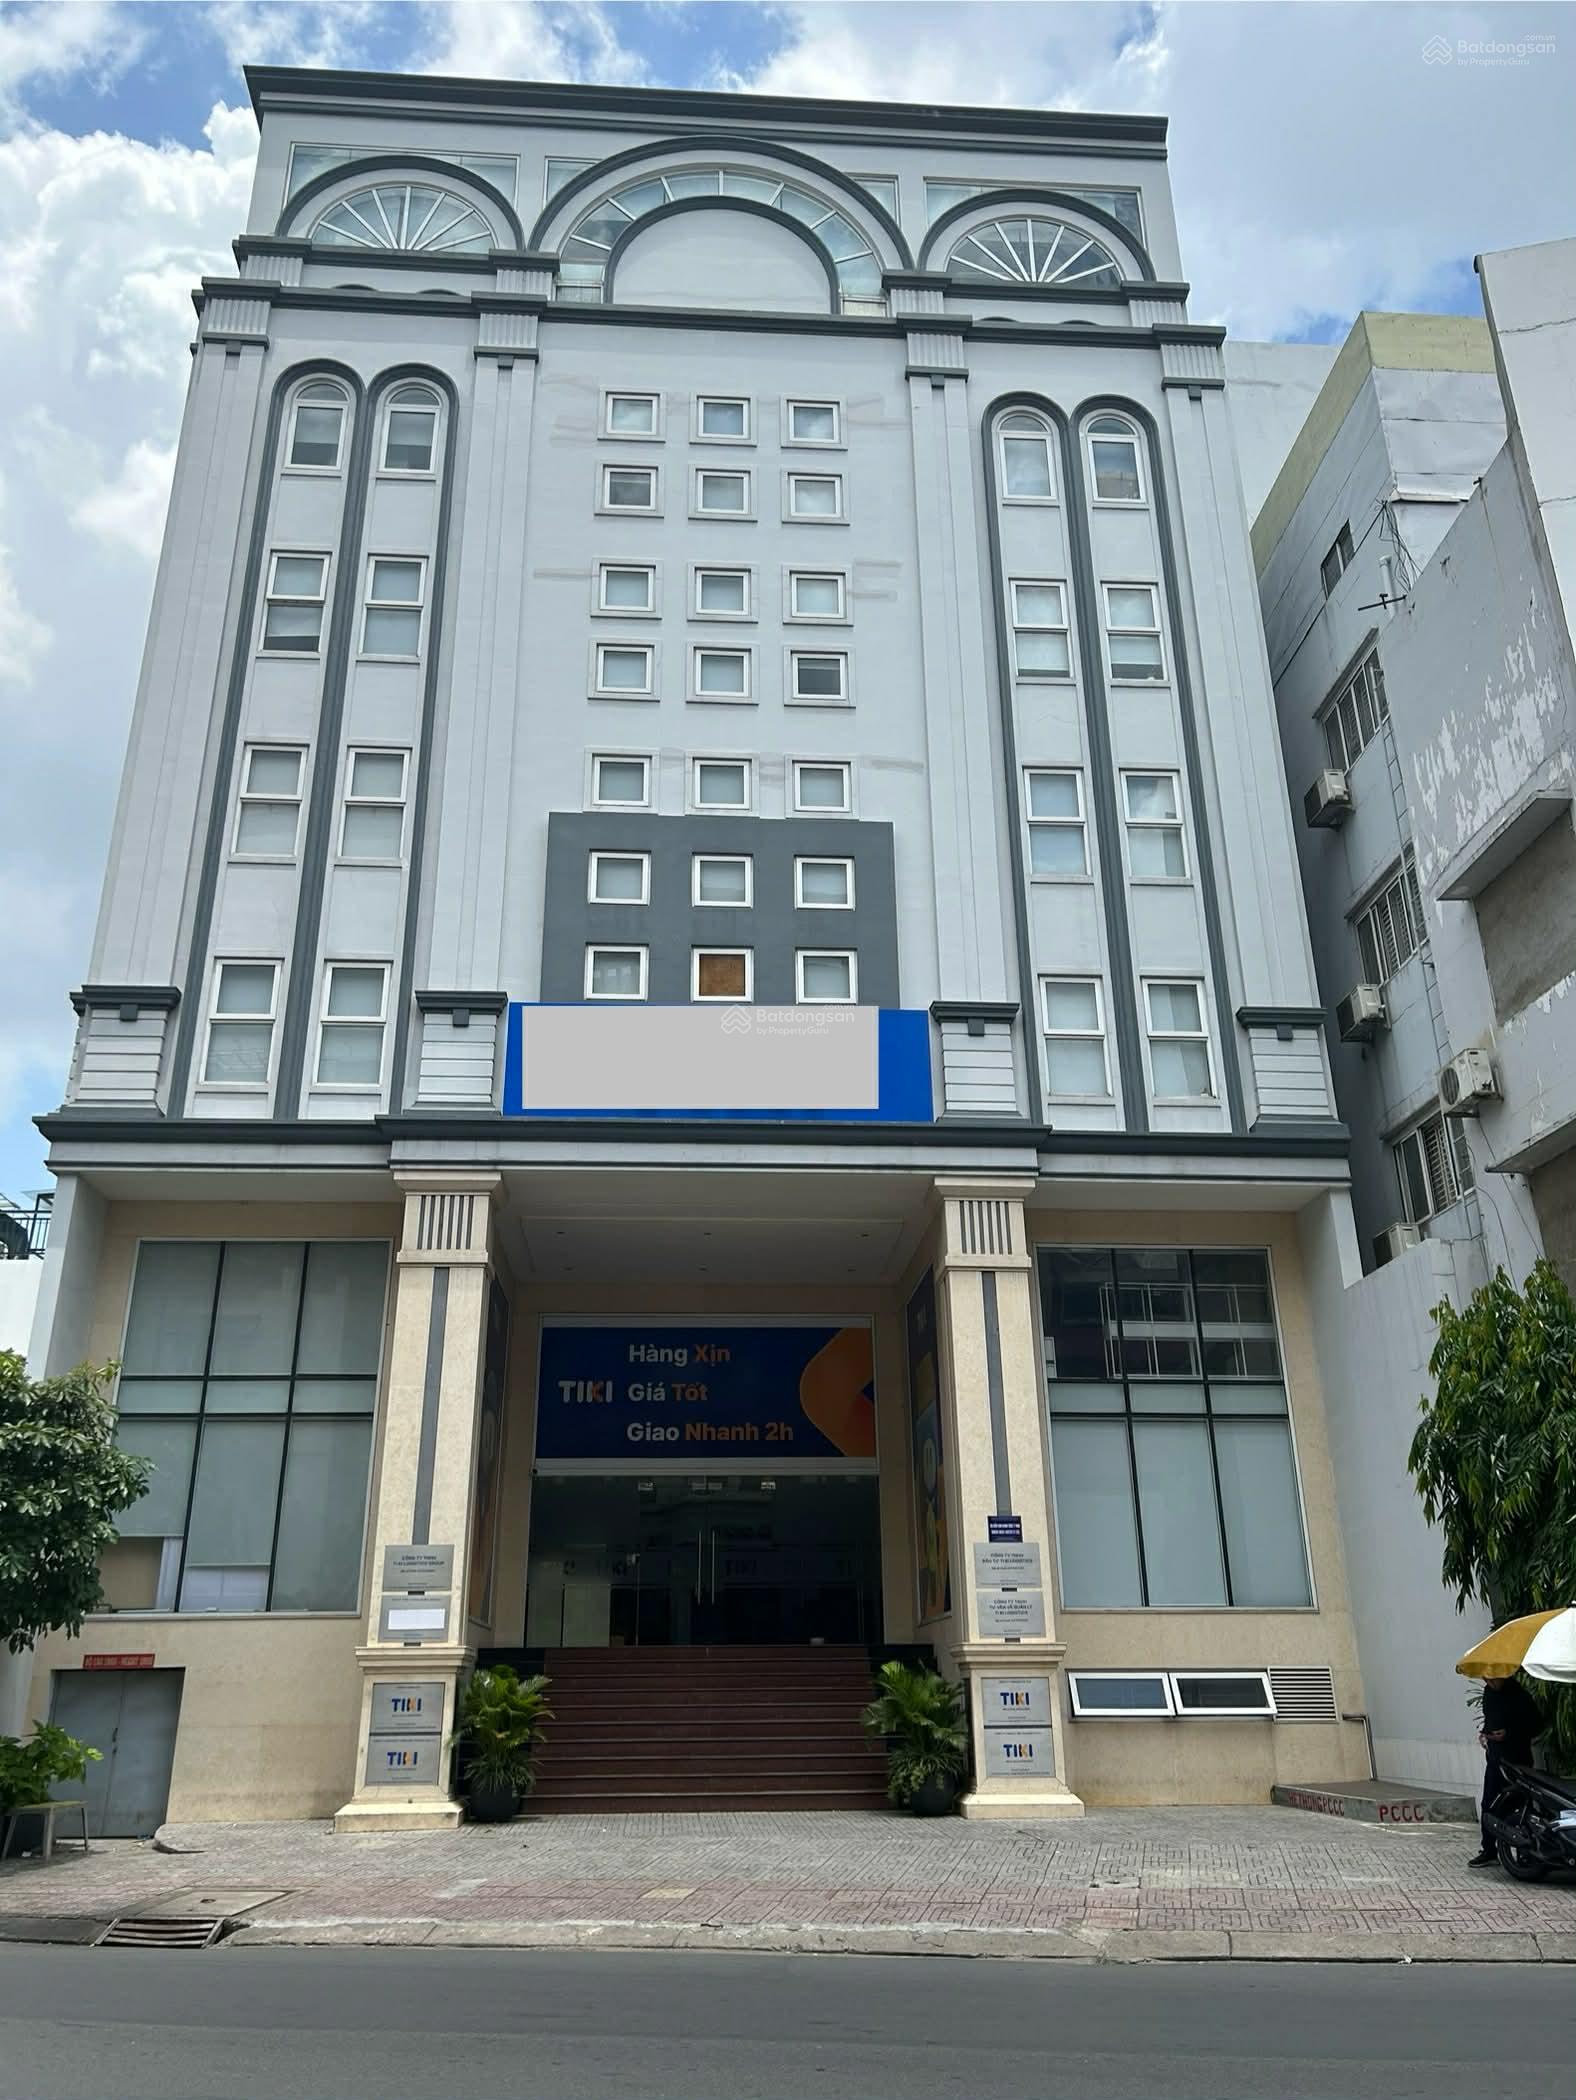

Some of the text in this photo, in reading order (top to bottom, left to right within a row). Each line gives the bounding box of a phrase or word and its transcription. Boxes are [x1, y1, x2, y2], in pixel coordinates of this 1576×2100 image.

[628, 1343, 731, 1367] Hàng Xịn
[557, 1379, 613, 1404] TIKI
[627, 1382, 708, 1402] Giá Tốt
[626, 1422, 794, 1442] Giao Nhanh 2h
[391, 1697, 422, 1712] TIKI
[1000, 1692, 1030, 1706] TIKI
[1003, 1744, 1033, 1758] TIKI
[1378, 1804, 1425, 1823] PCCC
